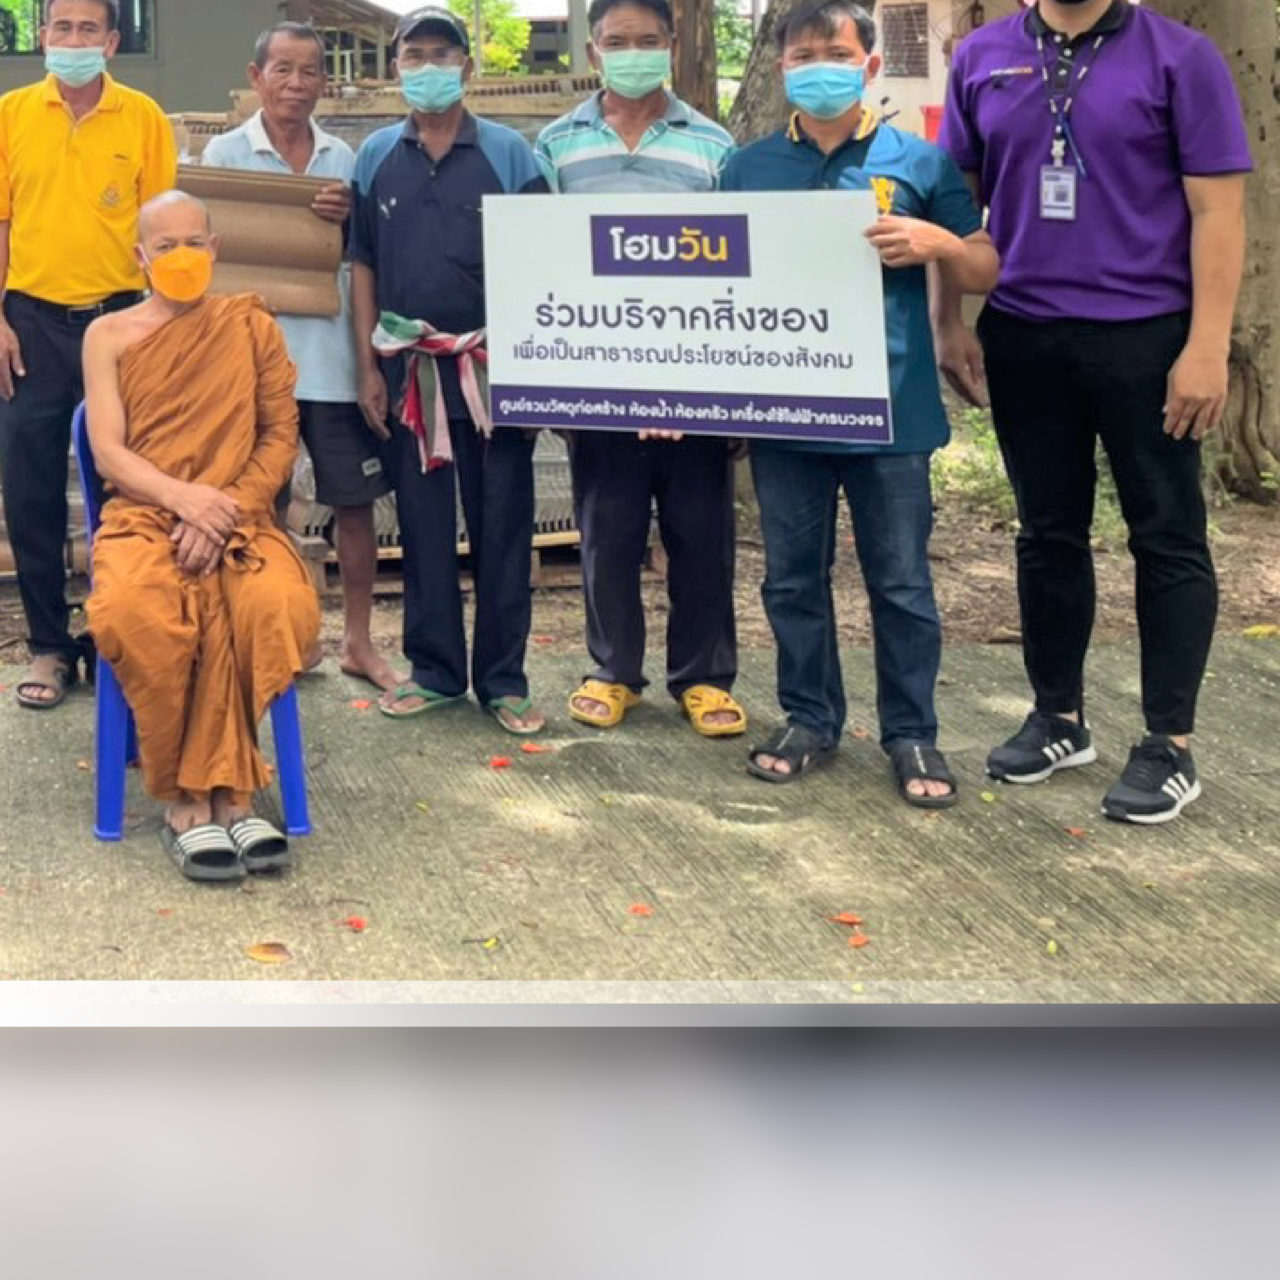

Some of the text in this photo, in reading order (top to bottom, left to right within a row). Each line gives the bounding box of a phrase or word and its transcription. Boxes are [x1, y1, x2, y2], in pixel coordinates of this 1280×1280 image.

[609, 226, 728, 261] โฮมวัน
[536, 287, 829, 332] ร่วมบริจาคสิ่งของ
[513, 335, 854, 369] เพื่อเป็นสาธารณประโยชน์ของสังคม
